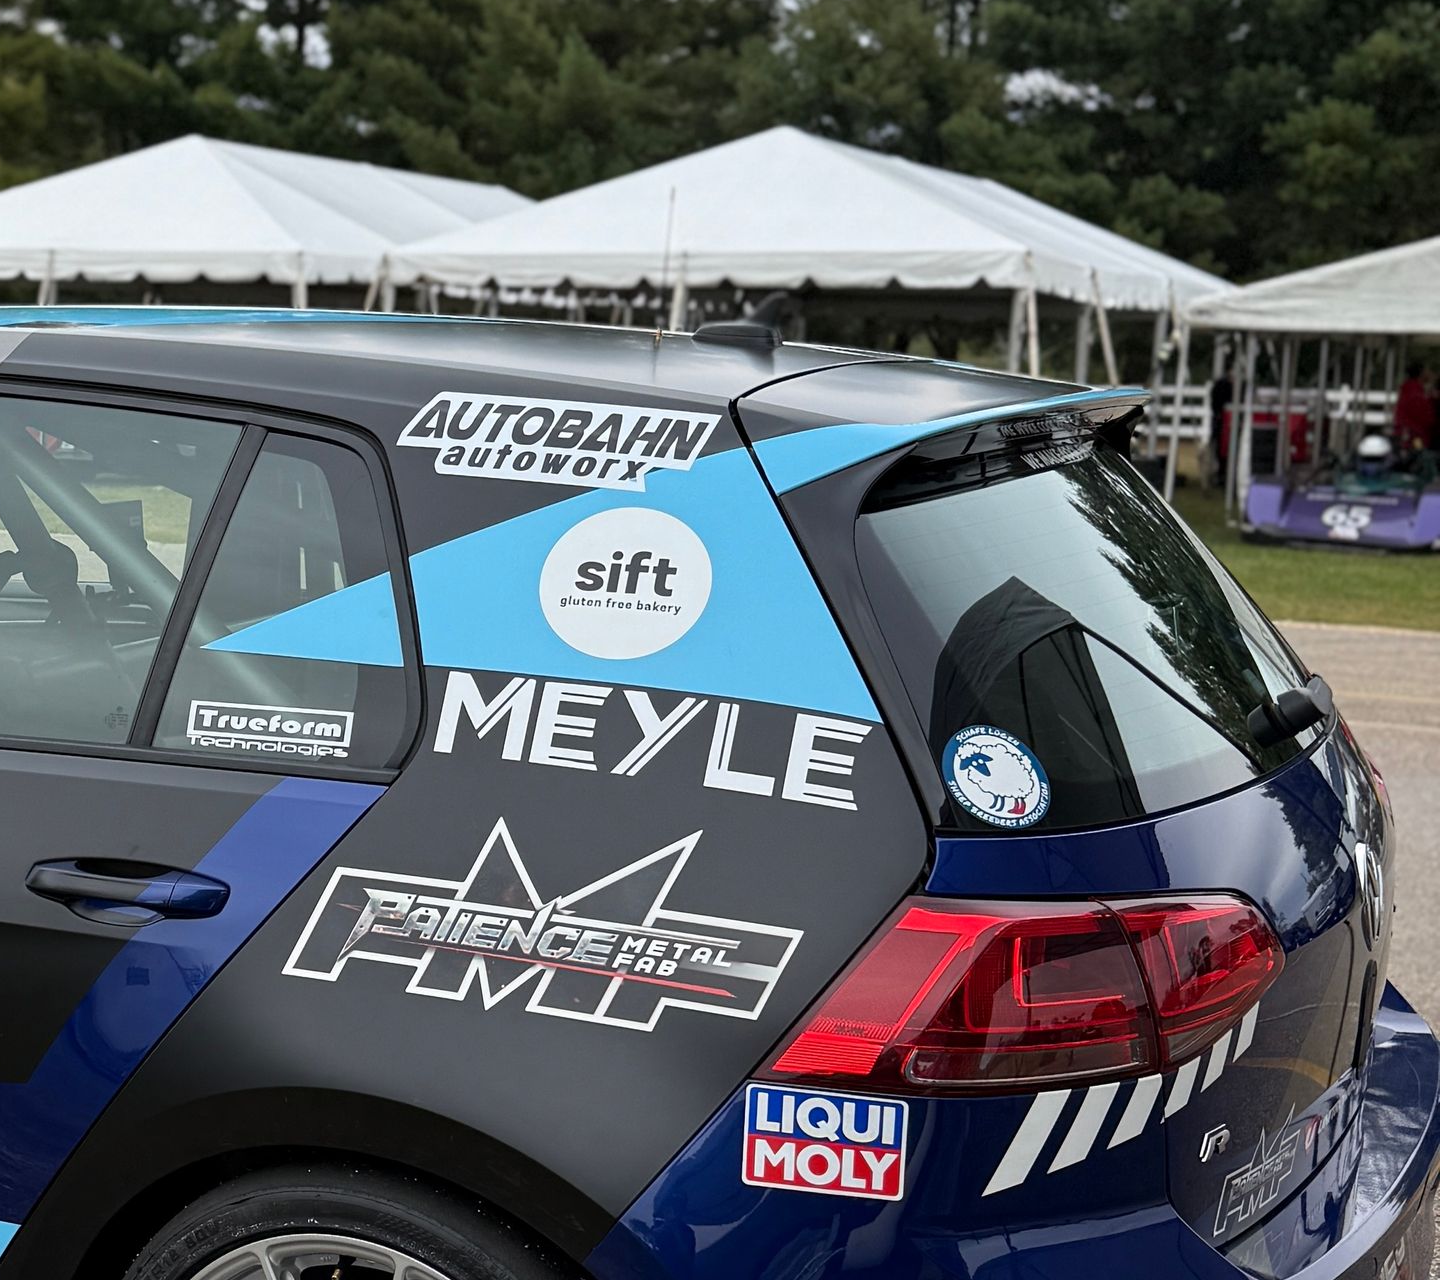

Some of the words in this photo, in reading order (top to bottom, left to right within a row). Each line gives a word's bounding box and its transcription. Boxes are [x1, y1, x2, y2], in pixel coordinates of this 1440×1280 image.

[412, 399, 709, 462] AUTOBAHN
[441, 442, 648, 484] autoworx
[1321, 504, 1373, 529] 65
[573, 549, 678, 598] sift
[559, 594, 602, 612] gluten
[605, 597, 633, 611] free
[636, 599, 682, 616] bakery
[198, 706, 343, 740] Trueform
[433, 669, 874, 812] MEYLE
[955, 727, 986, 743] SCHAFE
[988, 727, 1020, 746] LOGEN
[186, 734, 349, 758] Technologies
[947, 780, 972, 808] SHEEP
[970, 806, 1017, 827] BREEDERS
[1019, 781, 1049, 827] ASSOCIATION
[336, 886, 620, 964] PATIENCE
[619, 935, 733, 968] METAL
[611, 951, 679, 978] FAB
[756, 1091, 896, 1146] LIQUI
[753, 1138, 901, 1191] MOLY
